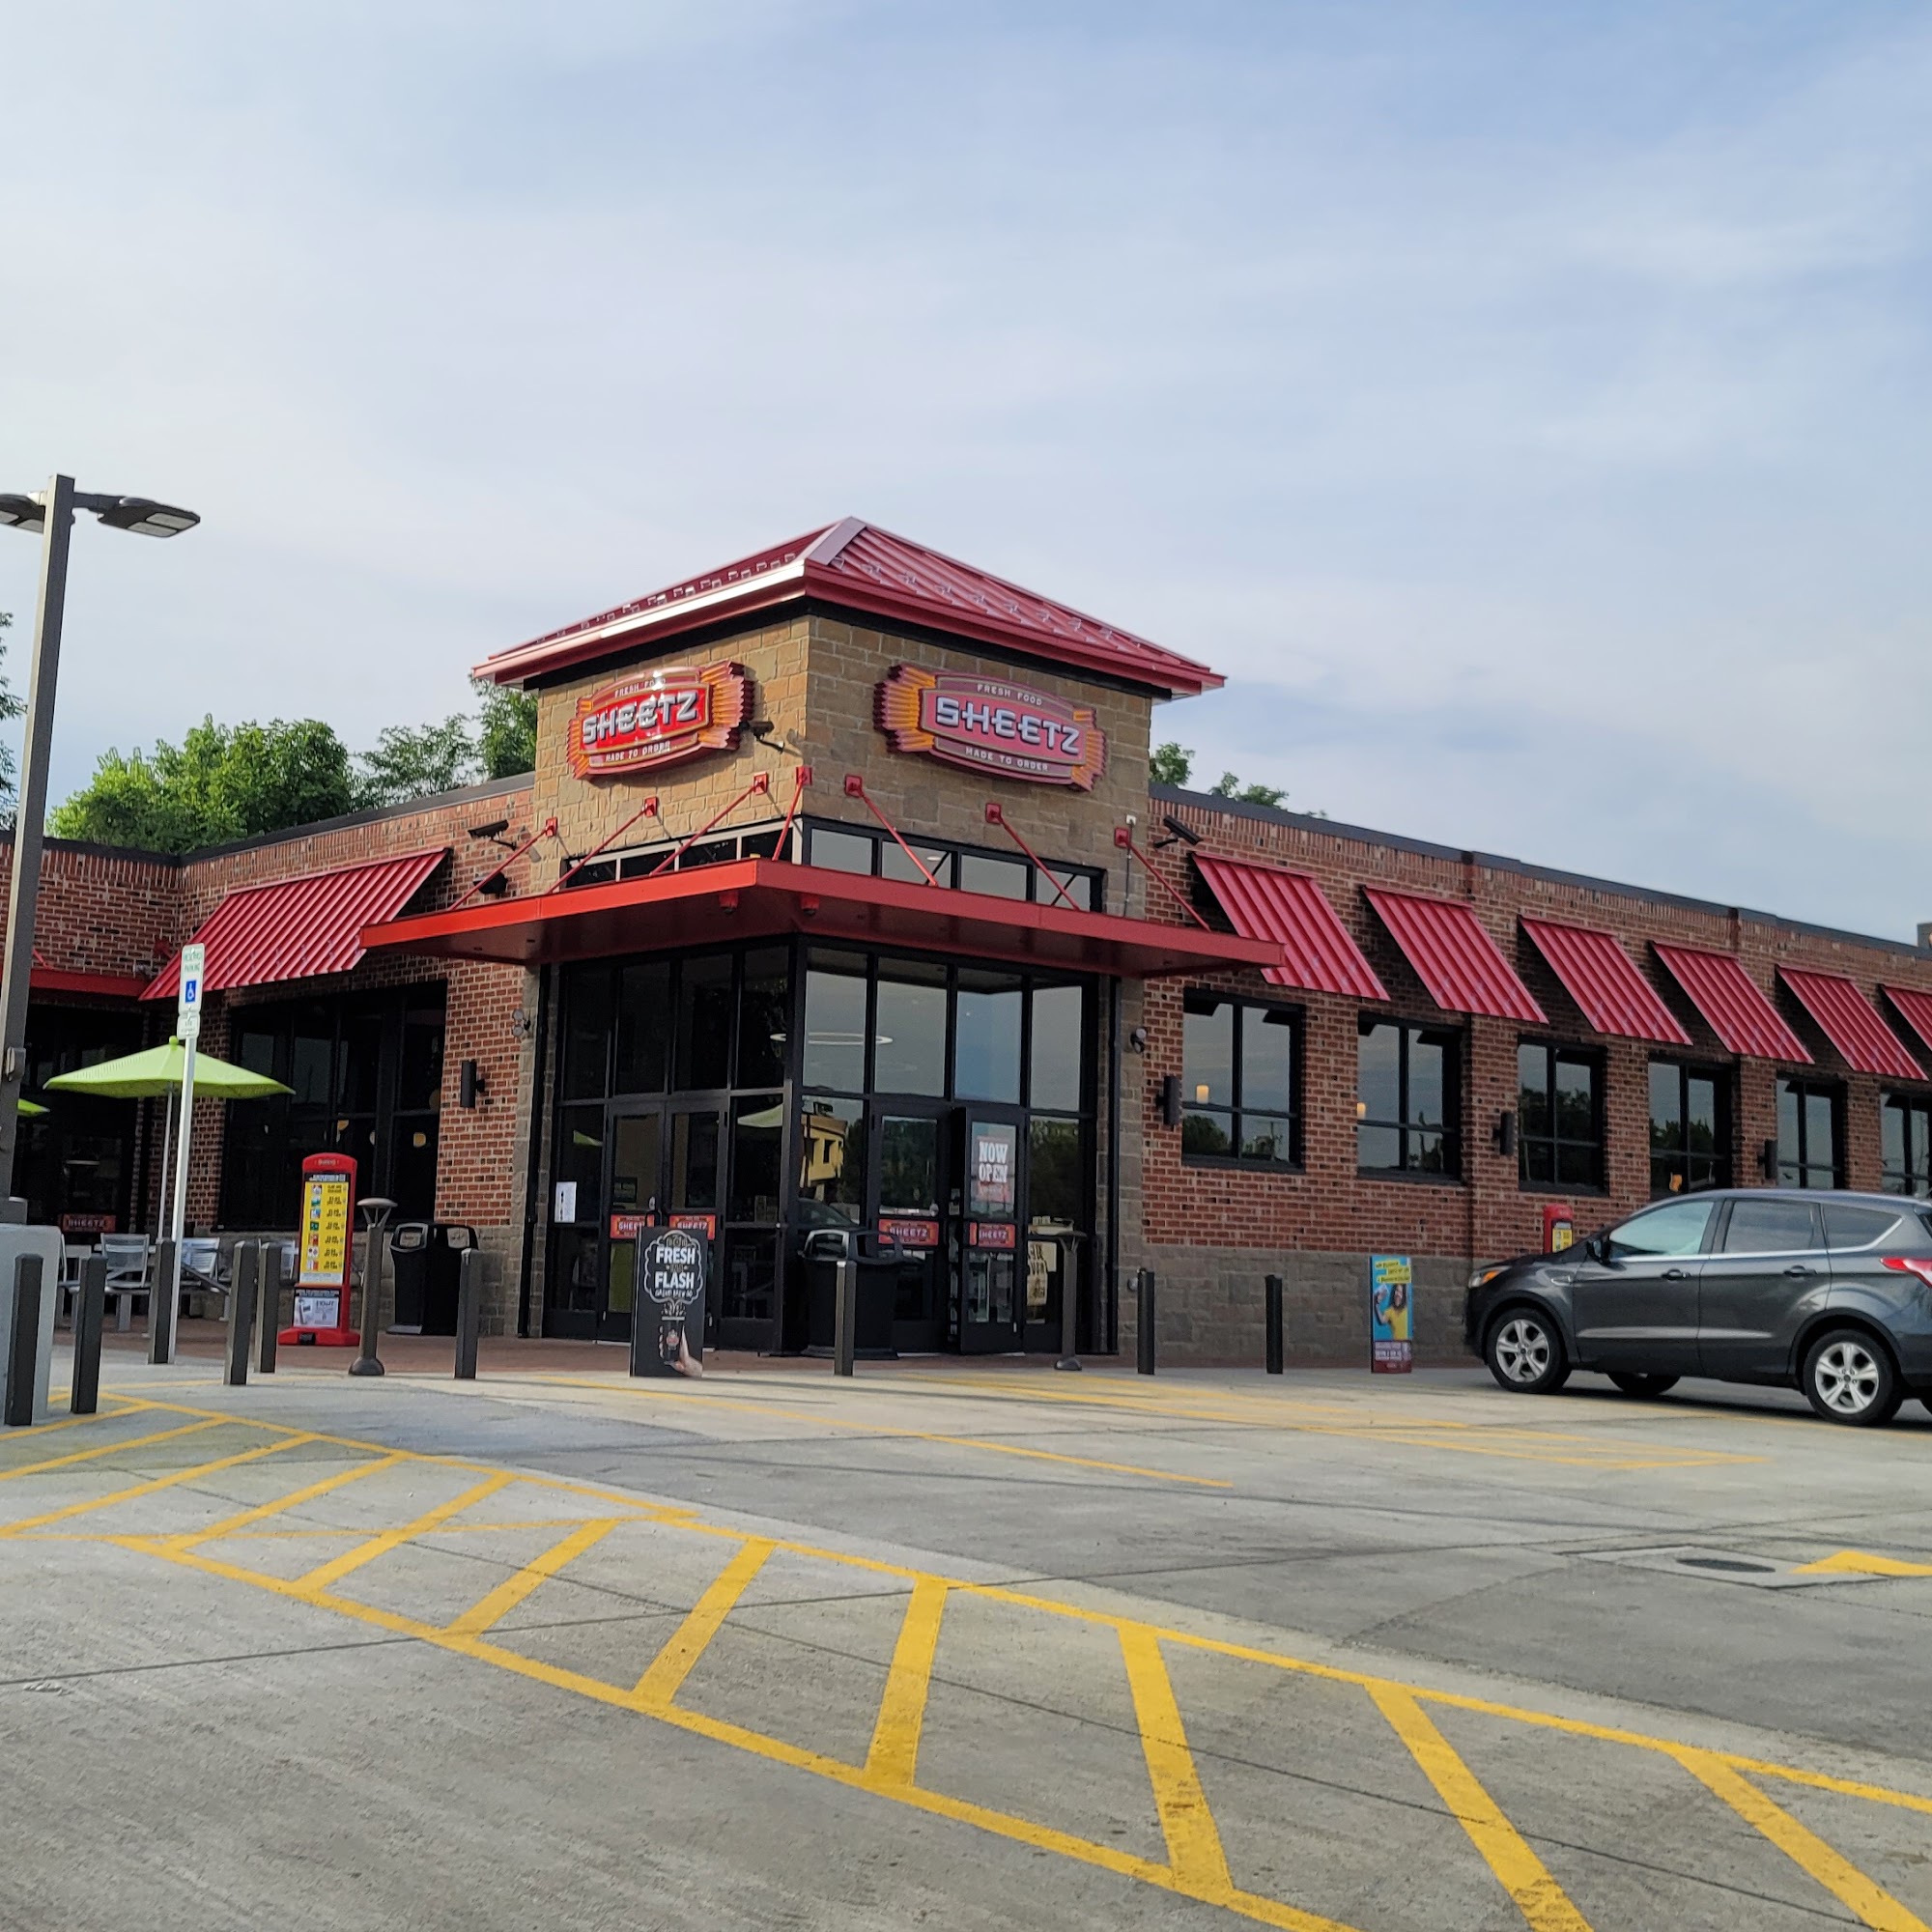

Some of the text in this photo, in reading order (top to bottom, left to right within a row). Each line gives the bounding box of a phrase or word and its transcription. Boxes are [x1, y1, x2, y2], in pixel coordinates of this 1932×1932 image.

[614, 685, 639, 698] FRESH
[977, 683, 1043, 706] FRESH FOOD
[582, 691, 697, 745] SHEETZ
[935, 696, 1081, 755] SHEETZ
[606, 740, 671, 762] MADE TO ORDER
[966, 747, 1049, 773] MADE TO ORDER
[979, 1141, 1009, 1164] NOW
[979, 1162, 1009, 1183] OPEN
[656, 1246, 696, 1264] FRESH
[655, 1271, 695, 1290] FLASH
